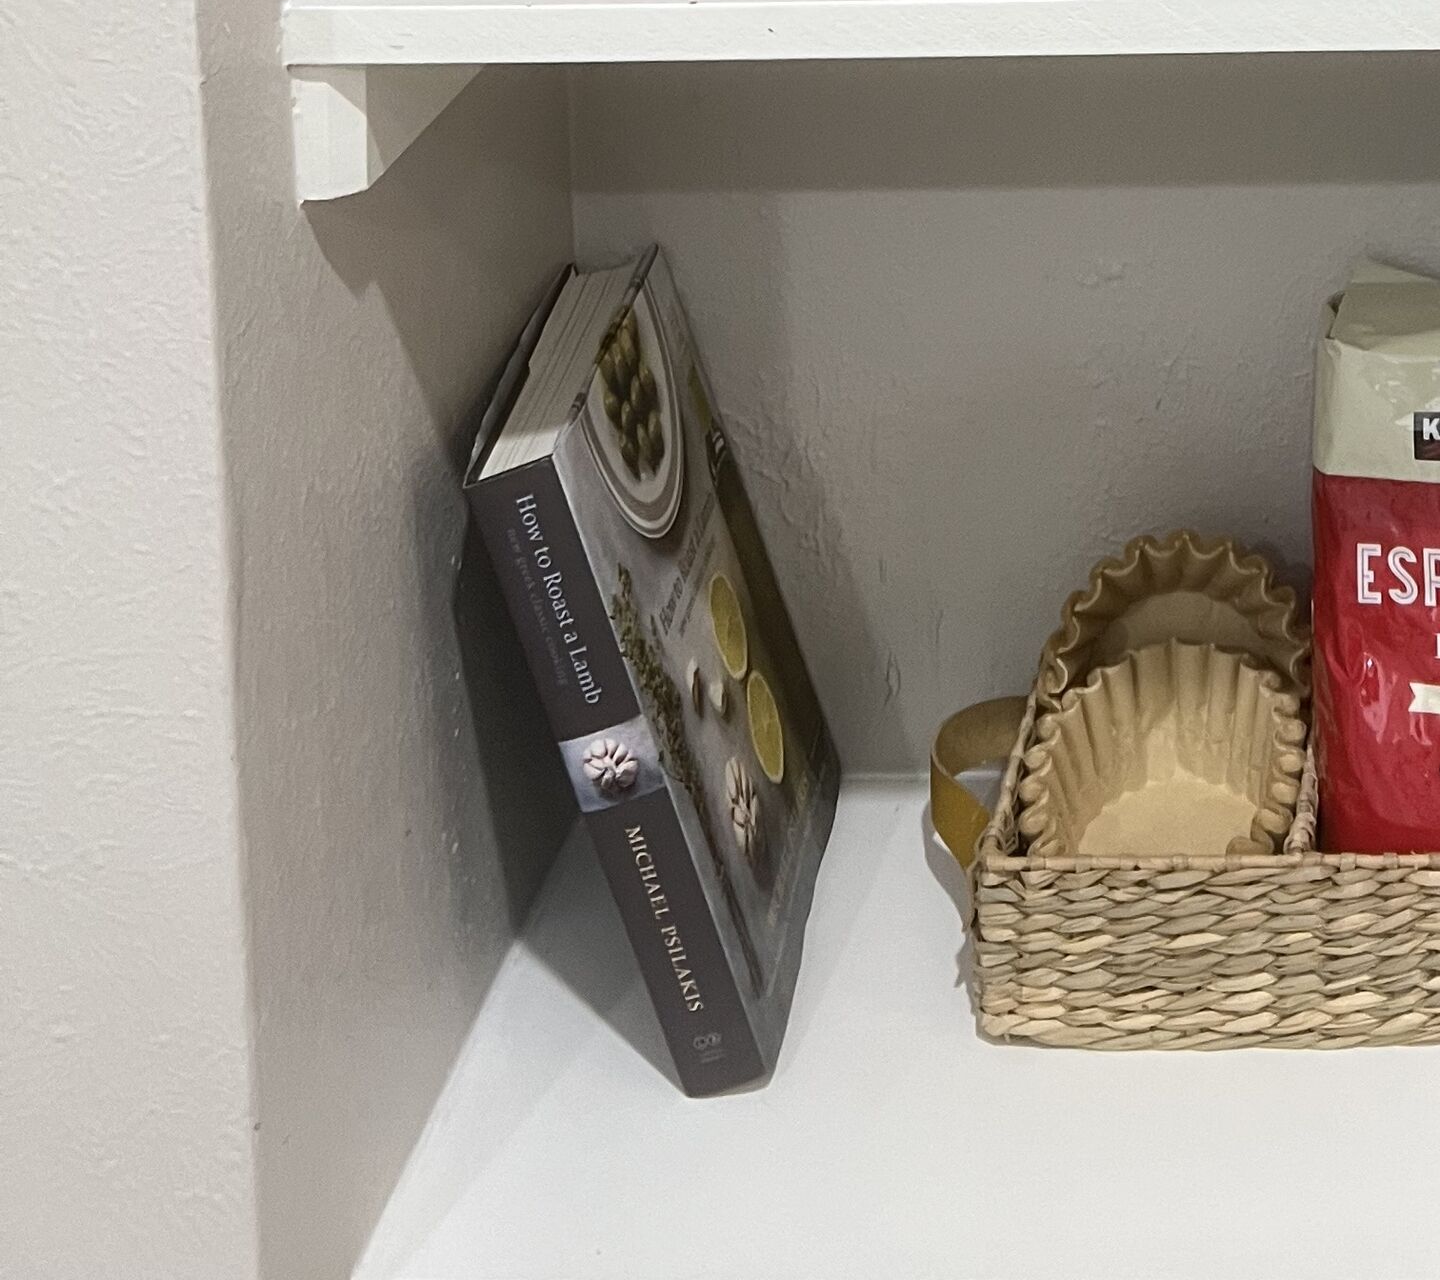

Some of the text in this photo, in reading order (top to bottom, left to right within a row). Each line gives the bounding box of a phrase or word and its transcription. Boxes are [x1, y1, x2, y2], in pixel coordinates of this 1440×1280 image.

[516, 494, 603, 705] How to Roast a Lamb
[625, 825, 704, 1012] MICHAEL PSILAKIS
